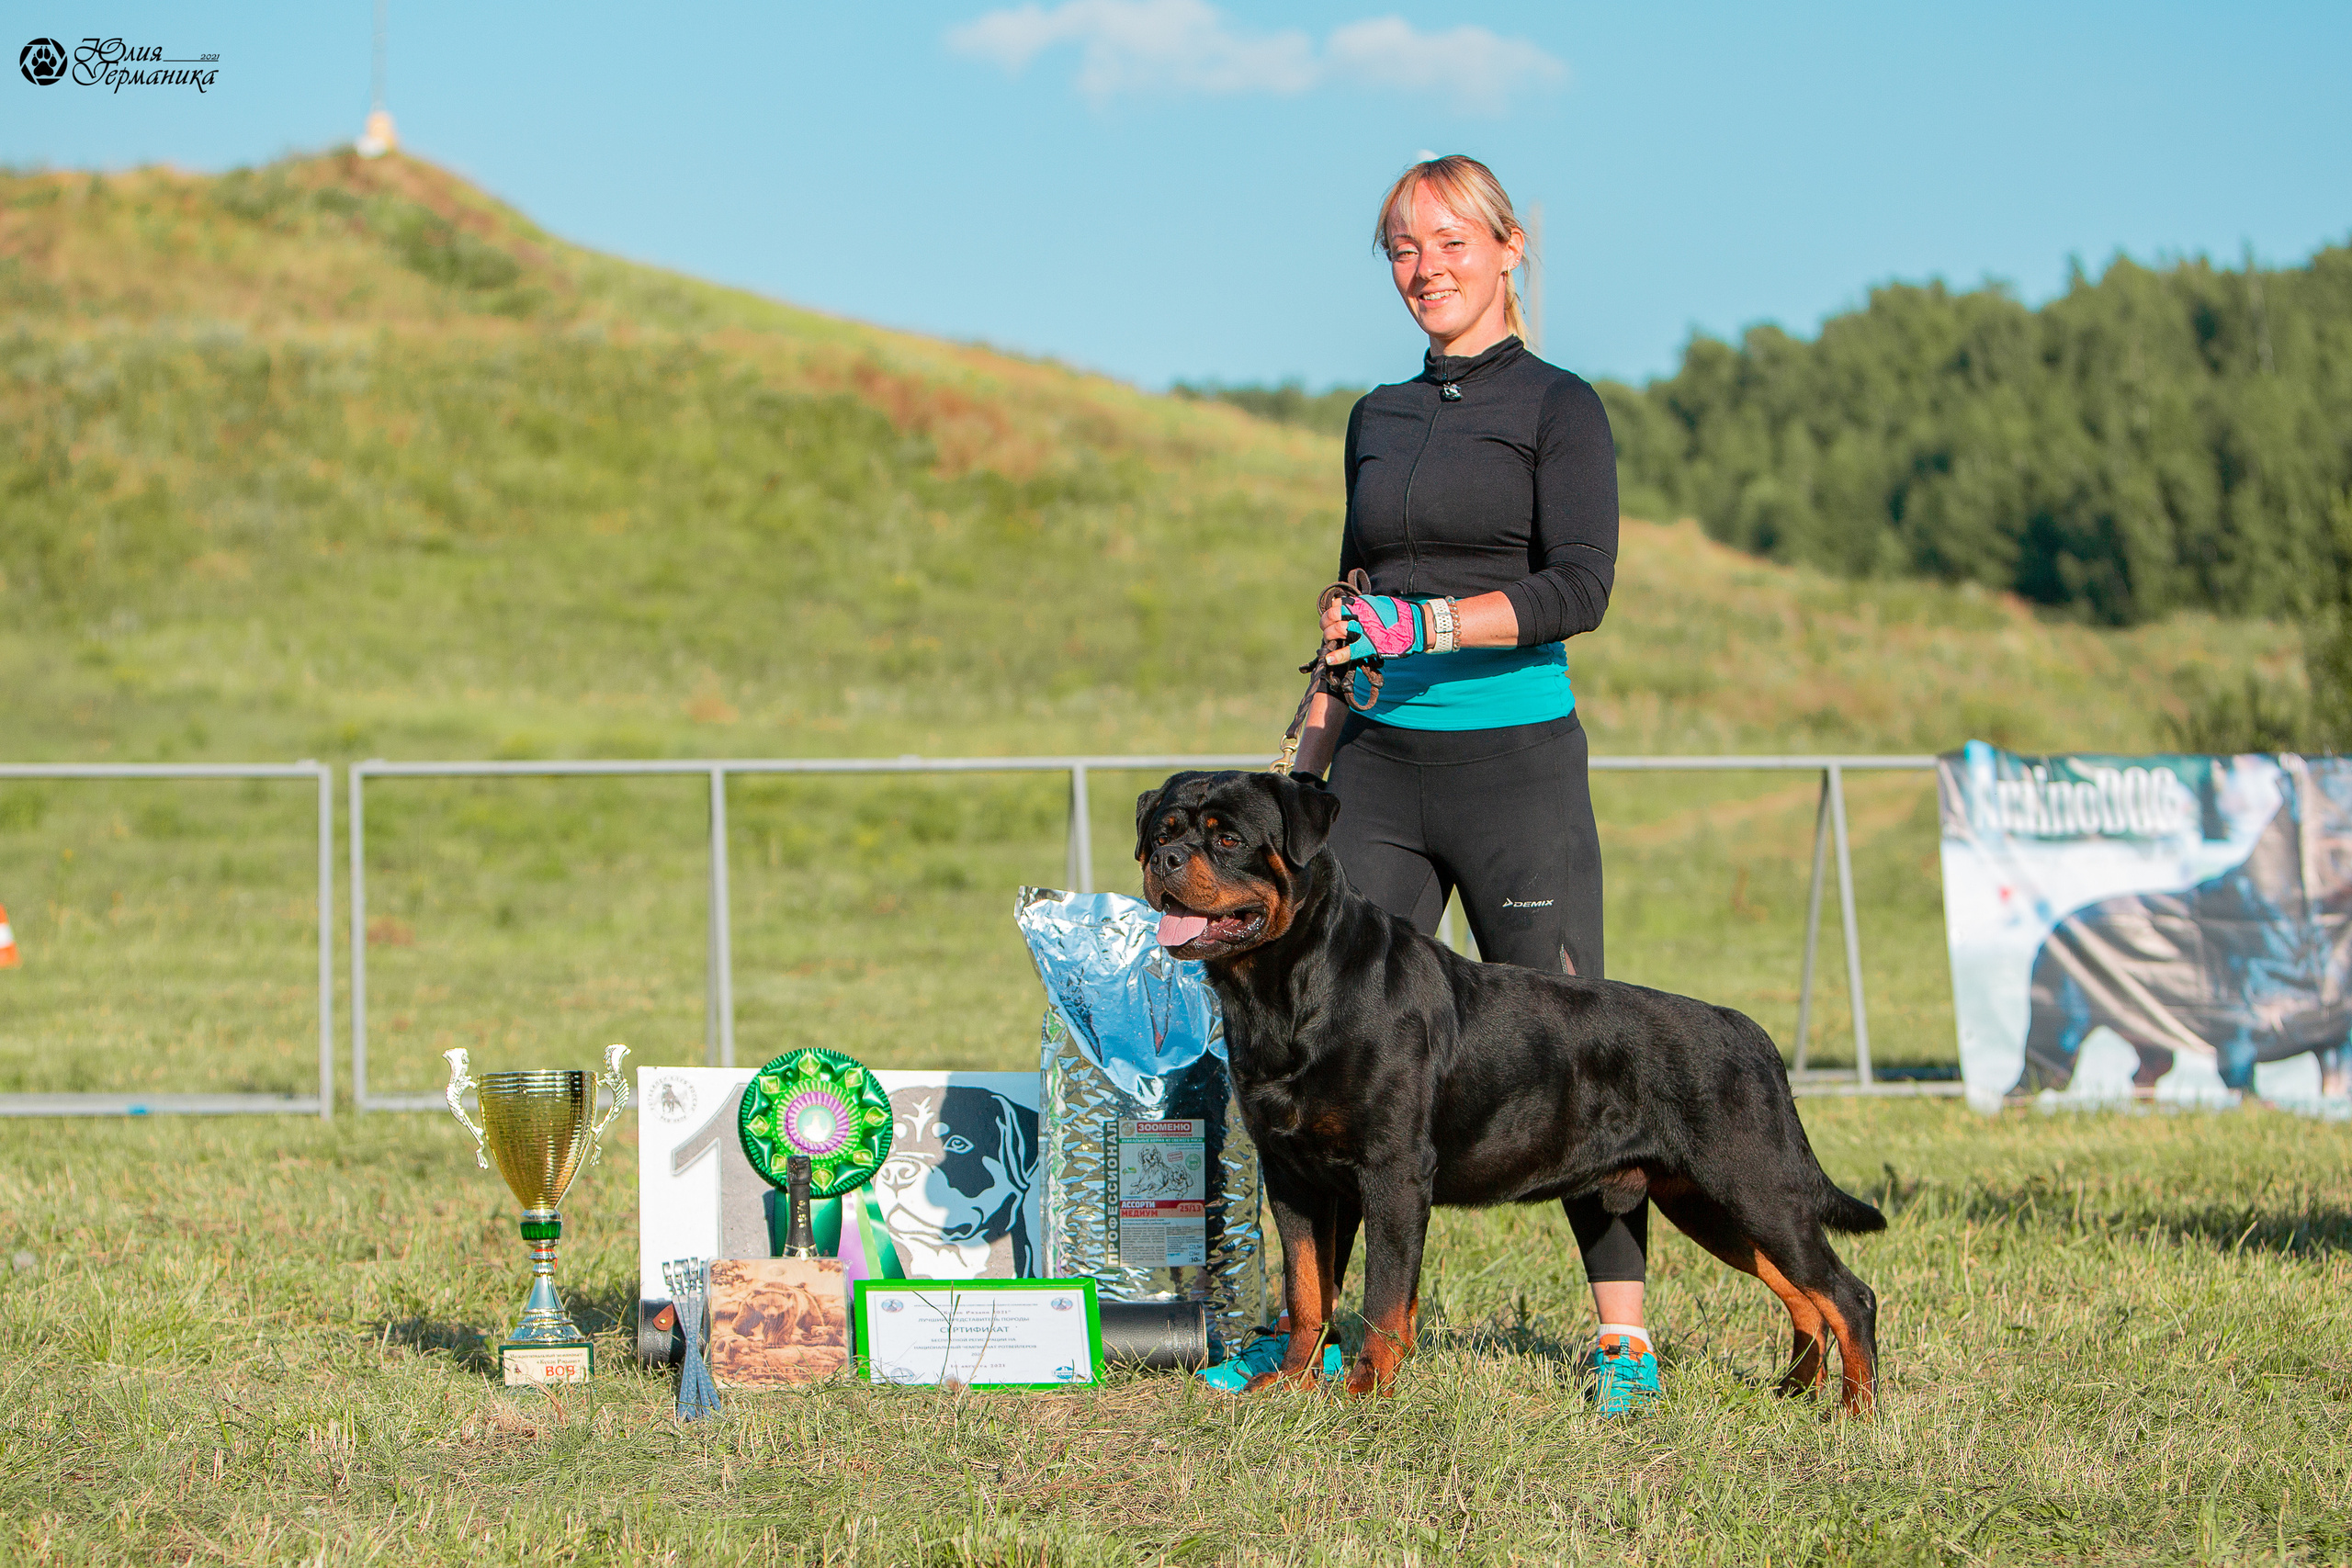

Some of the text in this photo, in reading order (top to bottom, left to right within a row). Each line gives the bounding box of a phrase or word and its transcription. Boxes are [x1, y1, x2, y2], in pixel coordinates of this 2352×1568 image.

[1513, 898, 1554, 908] DEMIX
[1138, 1123, 1191, 1132] ЗООМЕНЮ
[1106, 1122, 1119, 1266] ПРОФЕССИОНАЛ
[1121, 1201, 1156, 1209] АССОРТИ
[1180, 1204, 1202, 1213] 25/13
[1121, 1209, 1159, 1218] МЕДИУМ
[546, 1365, 575, 1377] BOB
